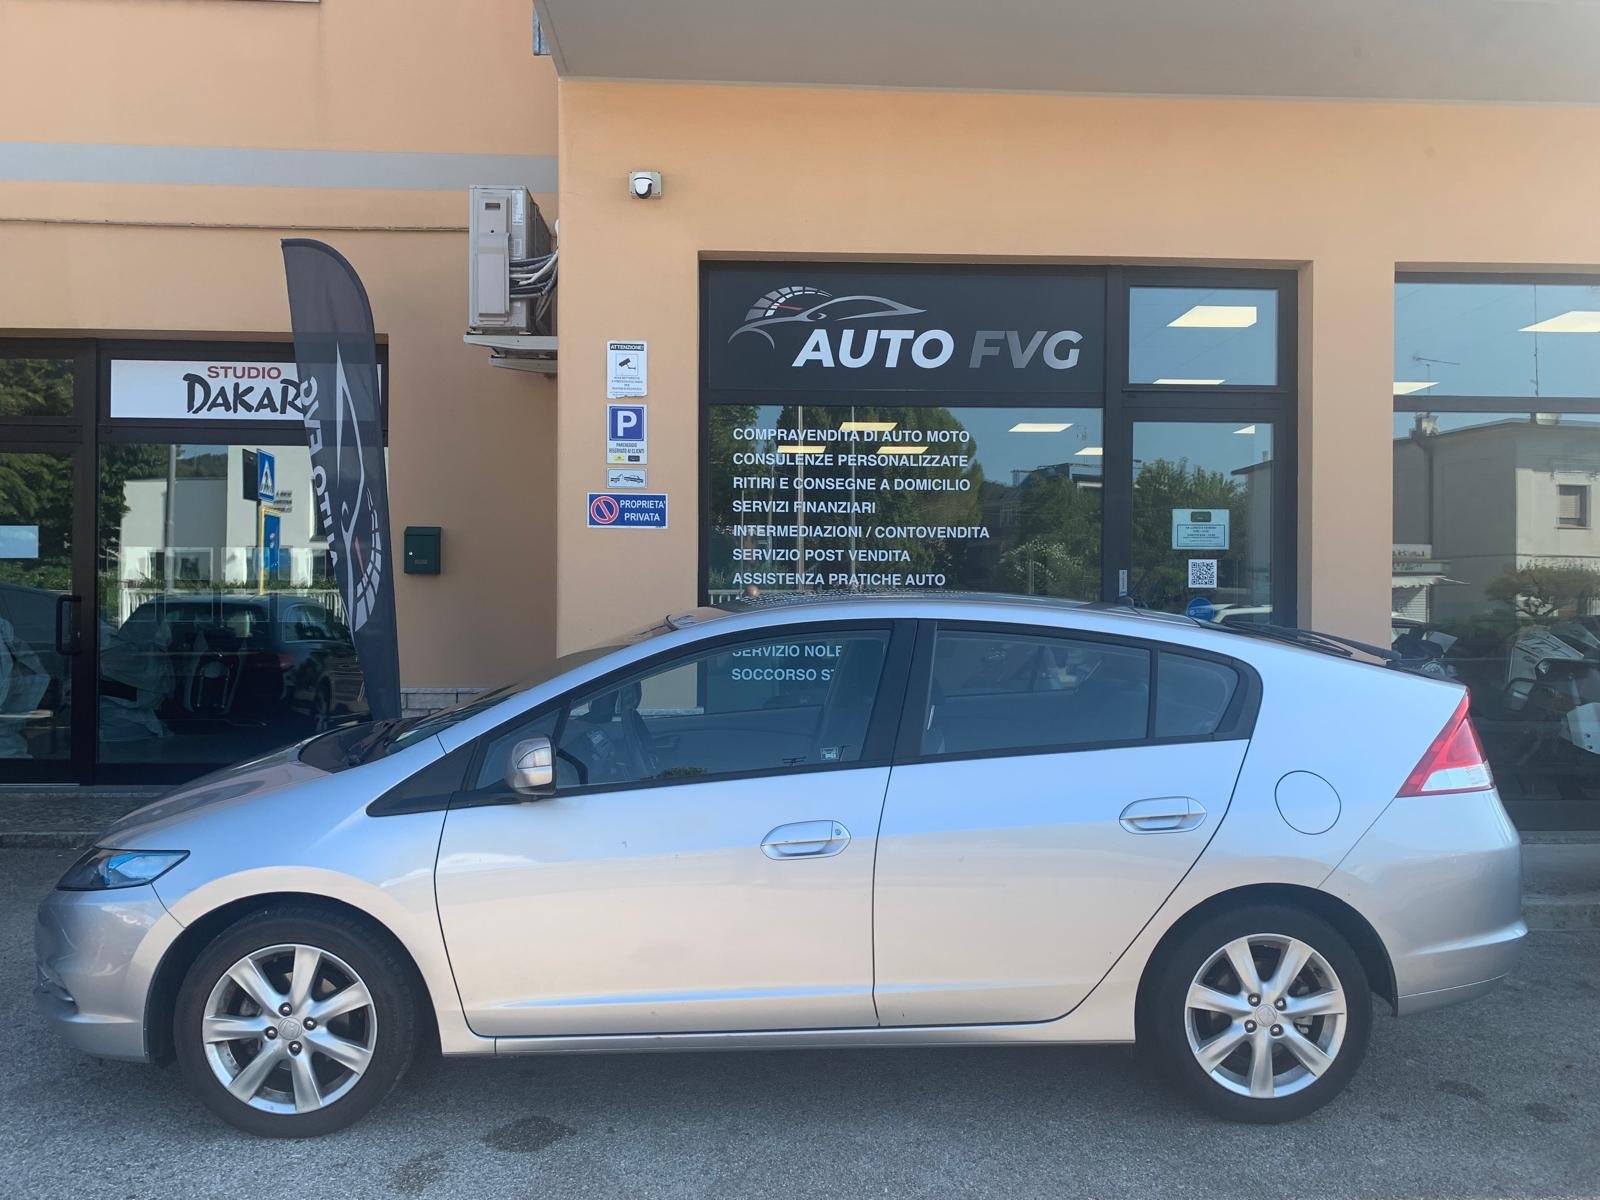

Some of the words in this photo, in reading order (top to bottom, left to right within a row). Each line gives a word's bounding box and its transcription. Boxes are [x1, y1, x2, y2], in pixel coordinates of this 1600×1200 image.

[791, 329, 955, 369] AUTO
[969, 330, 1084, 369] FVG
[207, 366, 282, 379] STUDIO
[183, 373, 304, 414] DAKAR
[618, 411, 637, 436] P
[733, 428, 860, 442] COMPRAVENDITA
[864, 431, 878, 442] DI
[882, 430, 923, 442] AUTO
[927, 431, 970, 443] MOTO
[733, 453, 834, 466] CONSULENZE
[838, 454, 968, 467] PERSONALIZZATE
[733, 477, 775, 489] RITIRI
[780, 477, 789, 489] E
[793, 478, 876, 490] CONSEGNE
[880, 479, 891, 490] A
[894, 479, 971, 491] DOMICILIO
[620, 500, 666, 509] PROPRIETA'
[733, 501, 789, 513] SERVIZI
[794, 502, 876, 513] FINANZIARI
[624, 513, 661, 521] PRIVATA
[733, 525, 862, 538] INTERMEDIAZIONI
[865, 526, 872, 538] /
[875, 526, 990, 538] CONTOVENDITA
[733, 549, 800, 561] SERVIZIO
[805, 550, 845, 561] POST
[848, 550, 911, 562] VENDITA
[733, 573, 825, 585] ASSISTENZA
[829, 573, 901, 585] PRATICHE
[905, 574, 946, 586] AUTO
[732, 645, 800, 657] SERVIZIO
[732, 668, 817, 681] SOCCORSO
[821, 669, 835, 681] S
